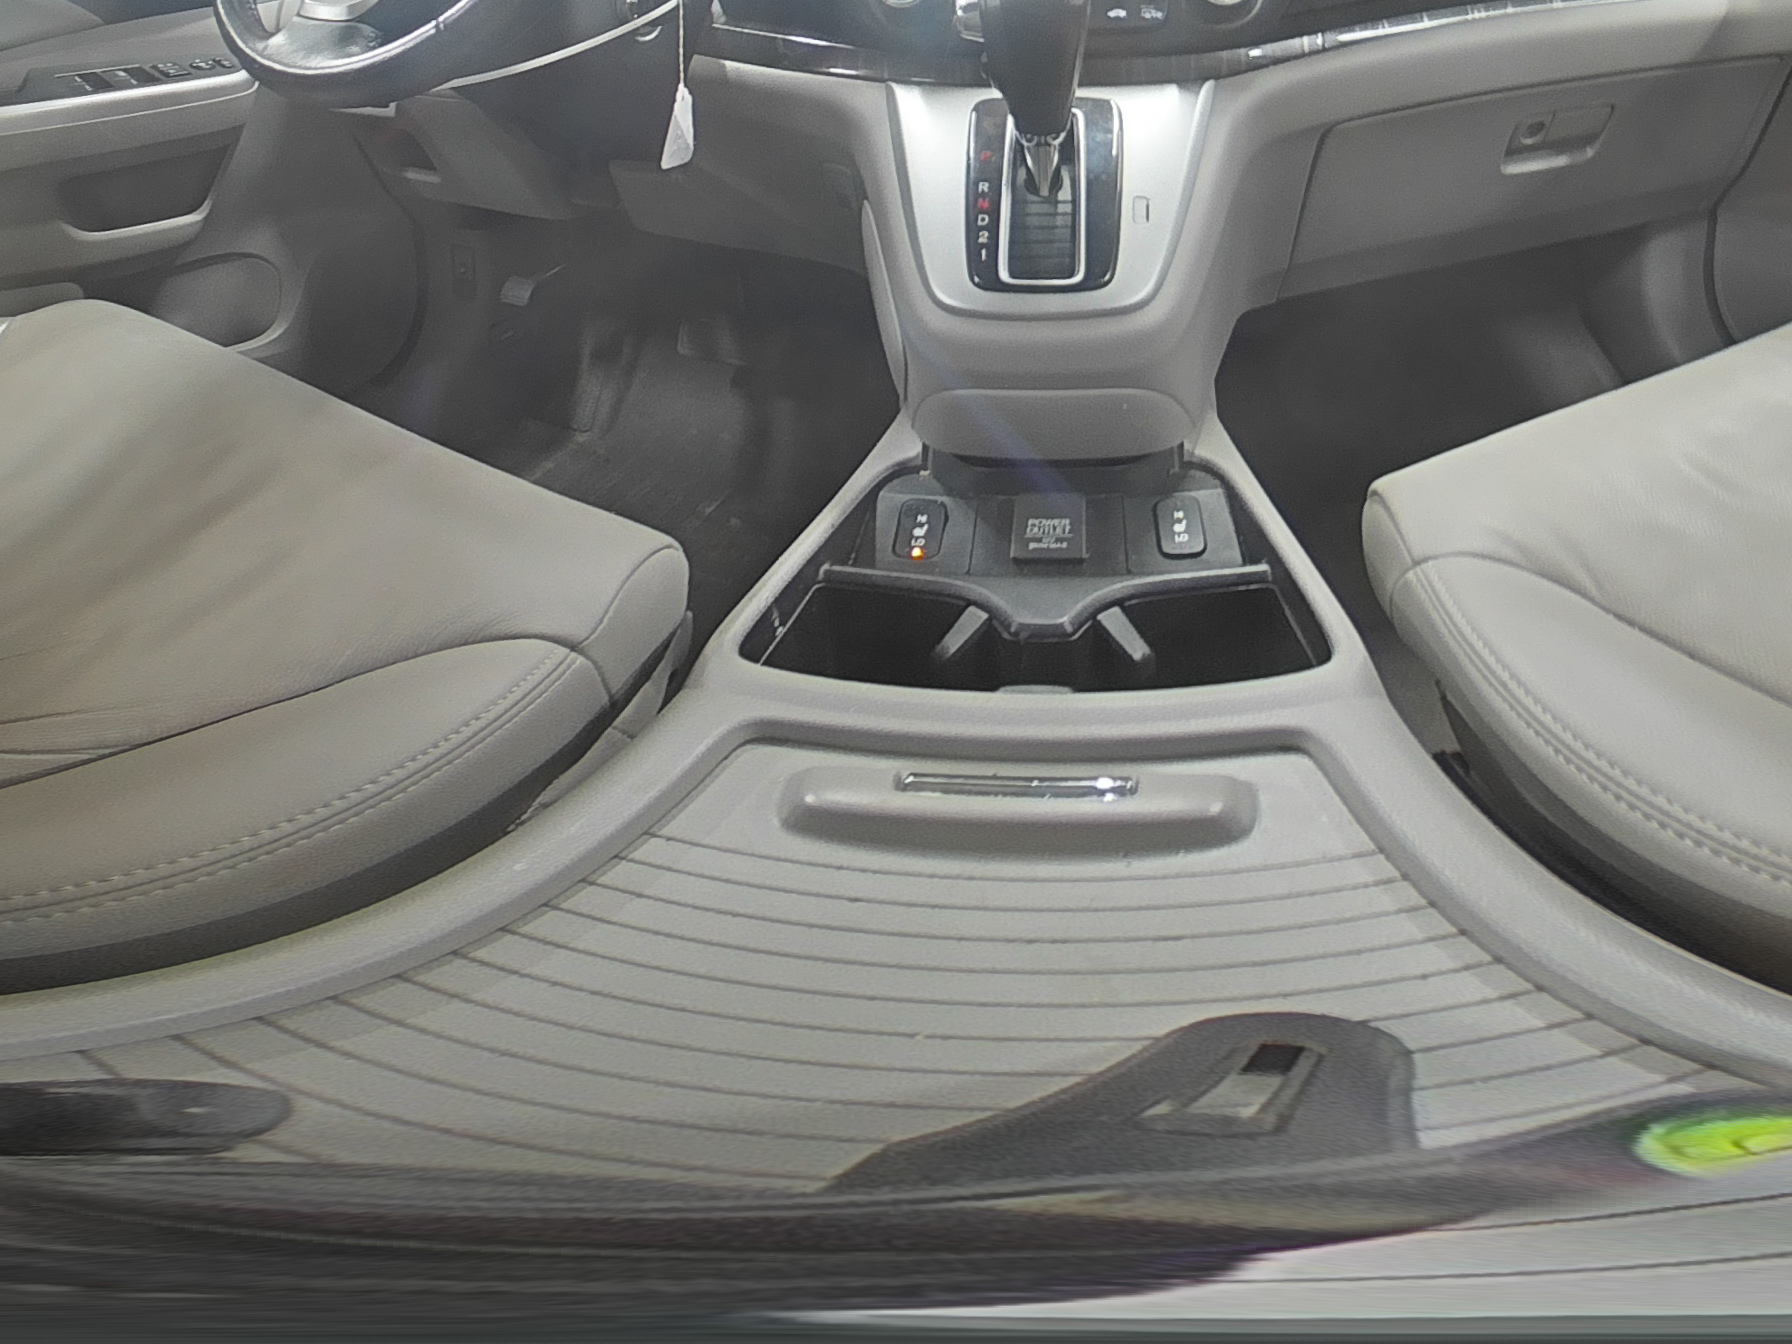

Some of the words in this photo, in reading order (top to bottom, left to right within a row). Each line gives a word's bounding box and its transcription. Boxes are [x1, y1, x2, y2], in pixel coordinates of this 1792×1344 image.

[978, 182, 989, 193] R
[977, 214, 989, 226] D
[978, 231, 989, 243] 2
[981, 248, 987, 261] 1
[1027, 518, 1071, 526] POWER
[1026, 525, 1071, 535] OUTLET
